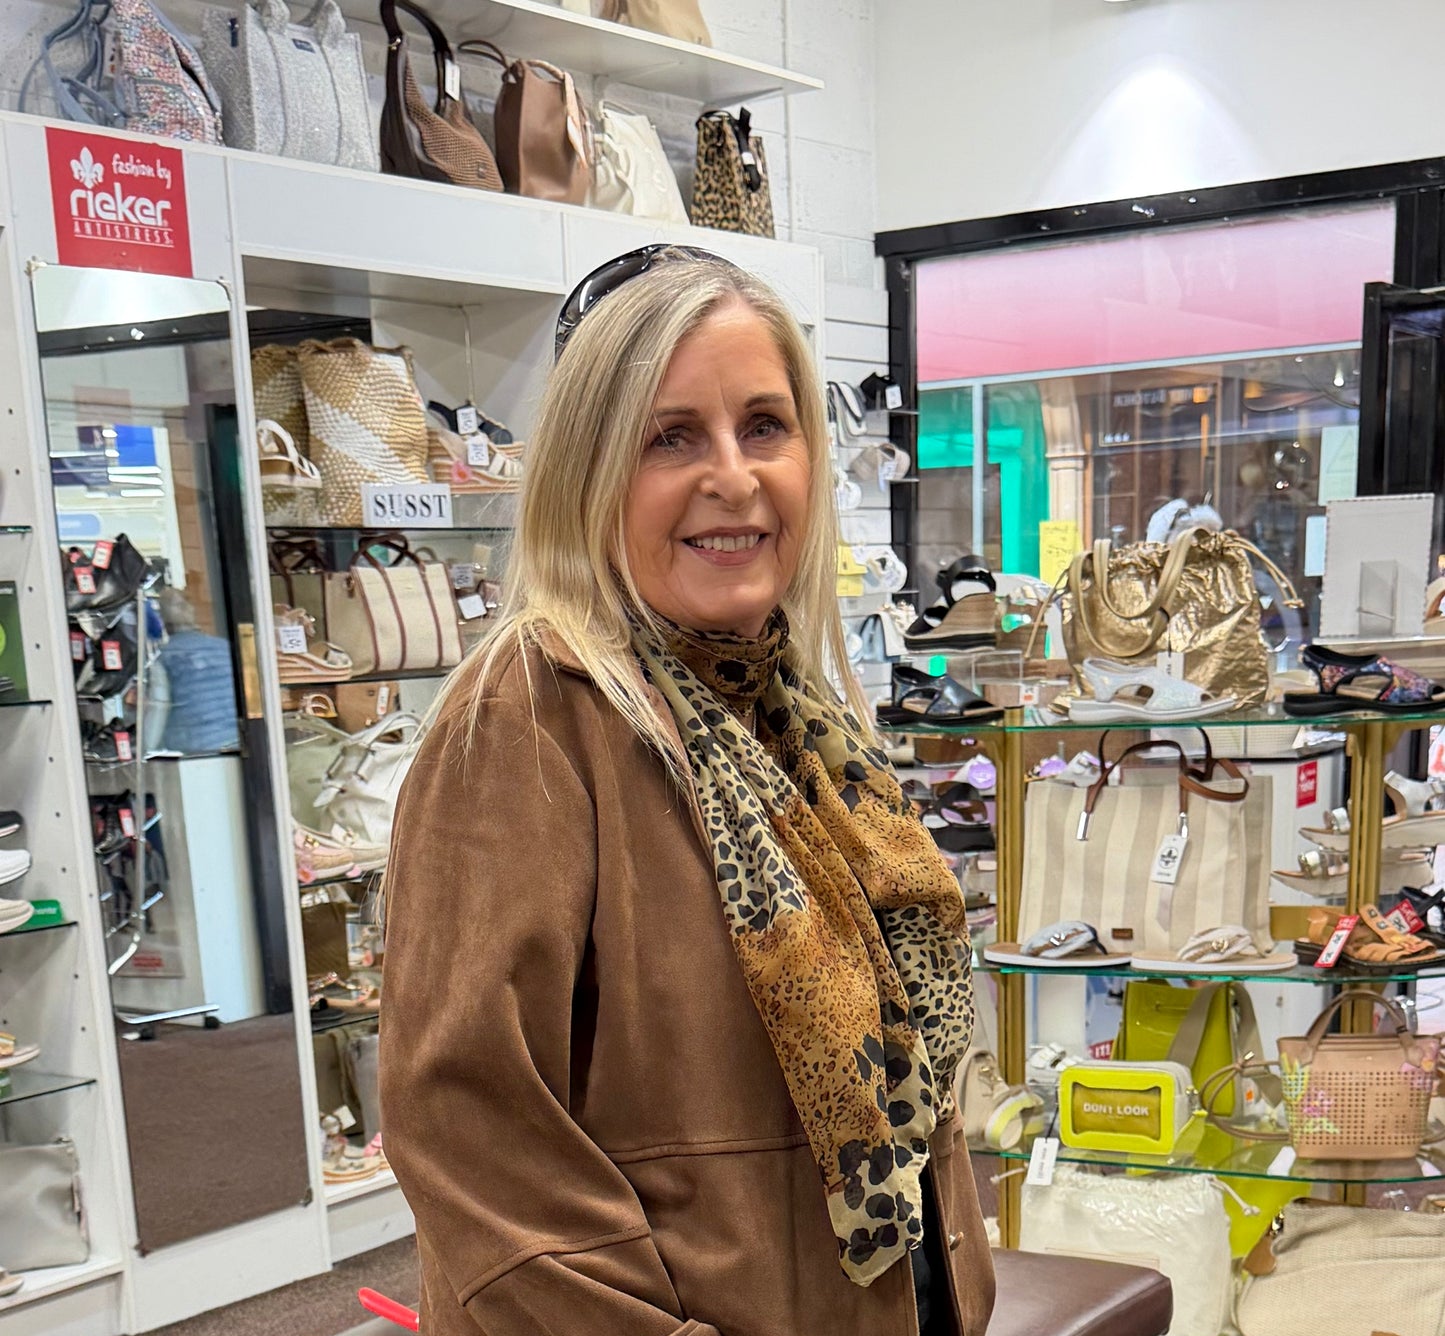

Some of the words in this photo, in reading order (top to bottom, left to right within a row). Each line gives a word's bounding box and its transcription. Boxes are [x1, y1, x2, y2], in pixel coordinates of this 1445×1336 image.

[112, 153, 155, 177] fashion
[156, 159, 171, 189] by
[70, 182, 172, 226] rieker
[374, 493, 447, 519] SUSST
[1117, 1105, 1149, 1116] LOOK
